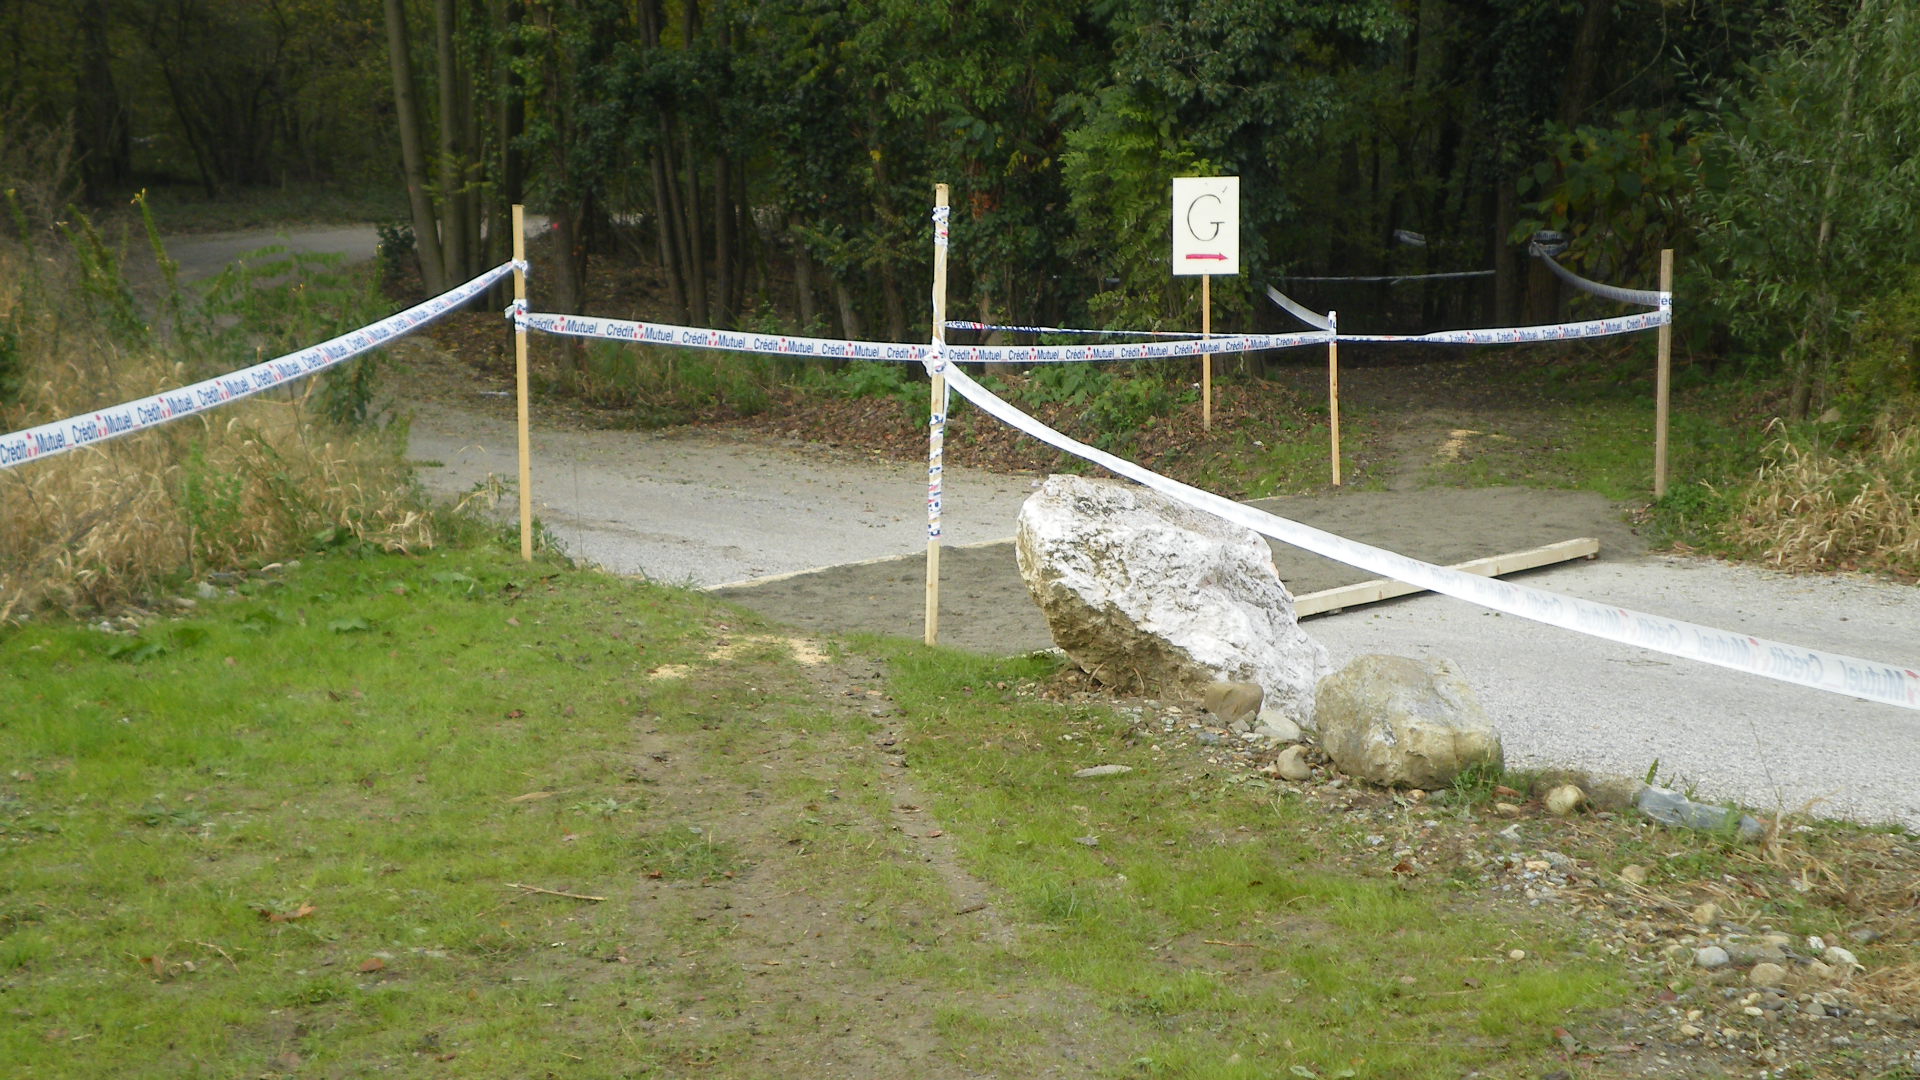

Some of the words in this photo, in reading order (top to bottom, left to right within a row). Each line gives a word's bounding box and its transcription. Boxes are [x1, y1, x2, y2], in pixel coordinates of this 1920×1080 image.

[1187, 194, 1225, 241] G
[565, 319, 598, 335] Mutuel
[606, 323, 634, 338] Crédit
[644, 327, 674, 342] Mutuel
[682, 331, 708, 346] Crédit
[717, 335, 746, 348] Mutuel
[753, 337, 779, 351] Crédit
[787, 340, 814, 354] Mutuel
[822, 343, 845, 356] Crédit
[854, 345, 880, 357] Mutuel
[886, 346, 910, 359] Crédit
[949, 348, 971, 360] Crédit
[979, 349, 1002, 361] Mutuel
[1008, 349, 1030, 361] Crédit
[1037, 349, 1060, 361] Mutuel
[1065, 348, 1086, 360] Crédit
[1093, 348, 1115, 359] Mutuel
[1120, 346, 1141, 358] Crédit
[1147, 345, 1169, 356] Mutuel
[1174, 343, 1193, 355] Crédit
[0, 440, 27, 464] Crédit
[35, 428, 66, 454] Mutuel
[72, 419, 98, 444] Crédit
[104, 411, 133, 434] Mutuel
[137, 402, 162, 425] Crédit
[166, 392, 194, 415] Mutuel
[197, 384, 221, 406] Crédit
[223, 376, 250, 397] Mutuel
